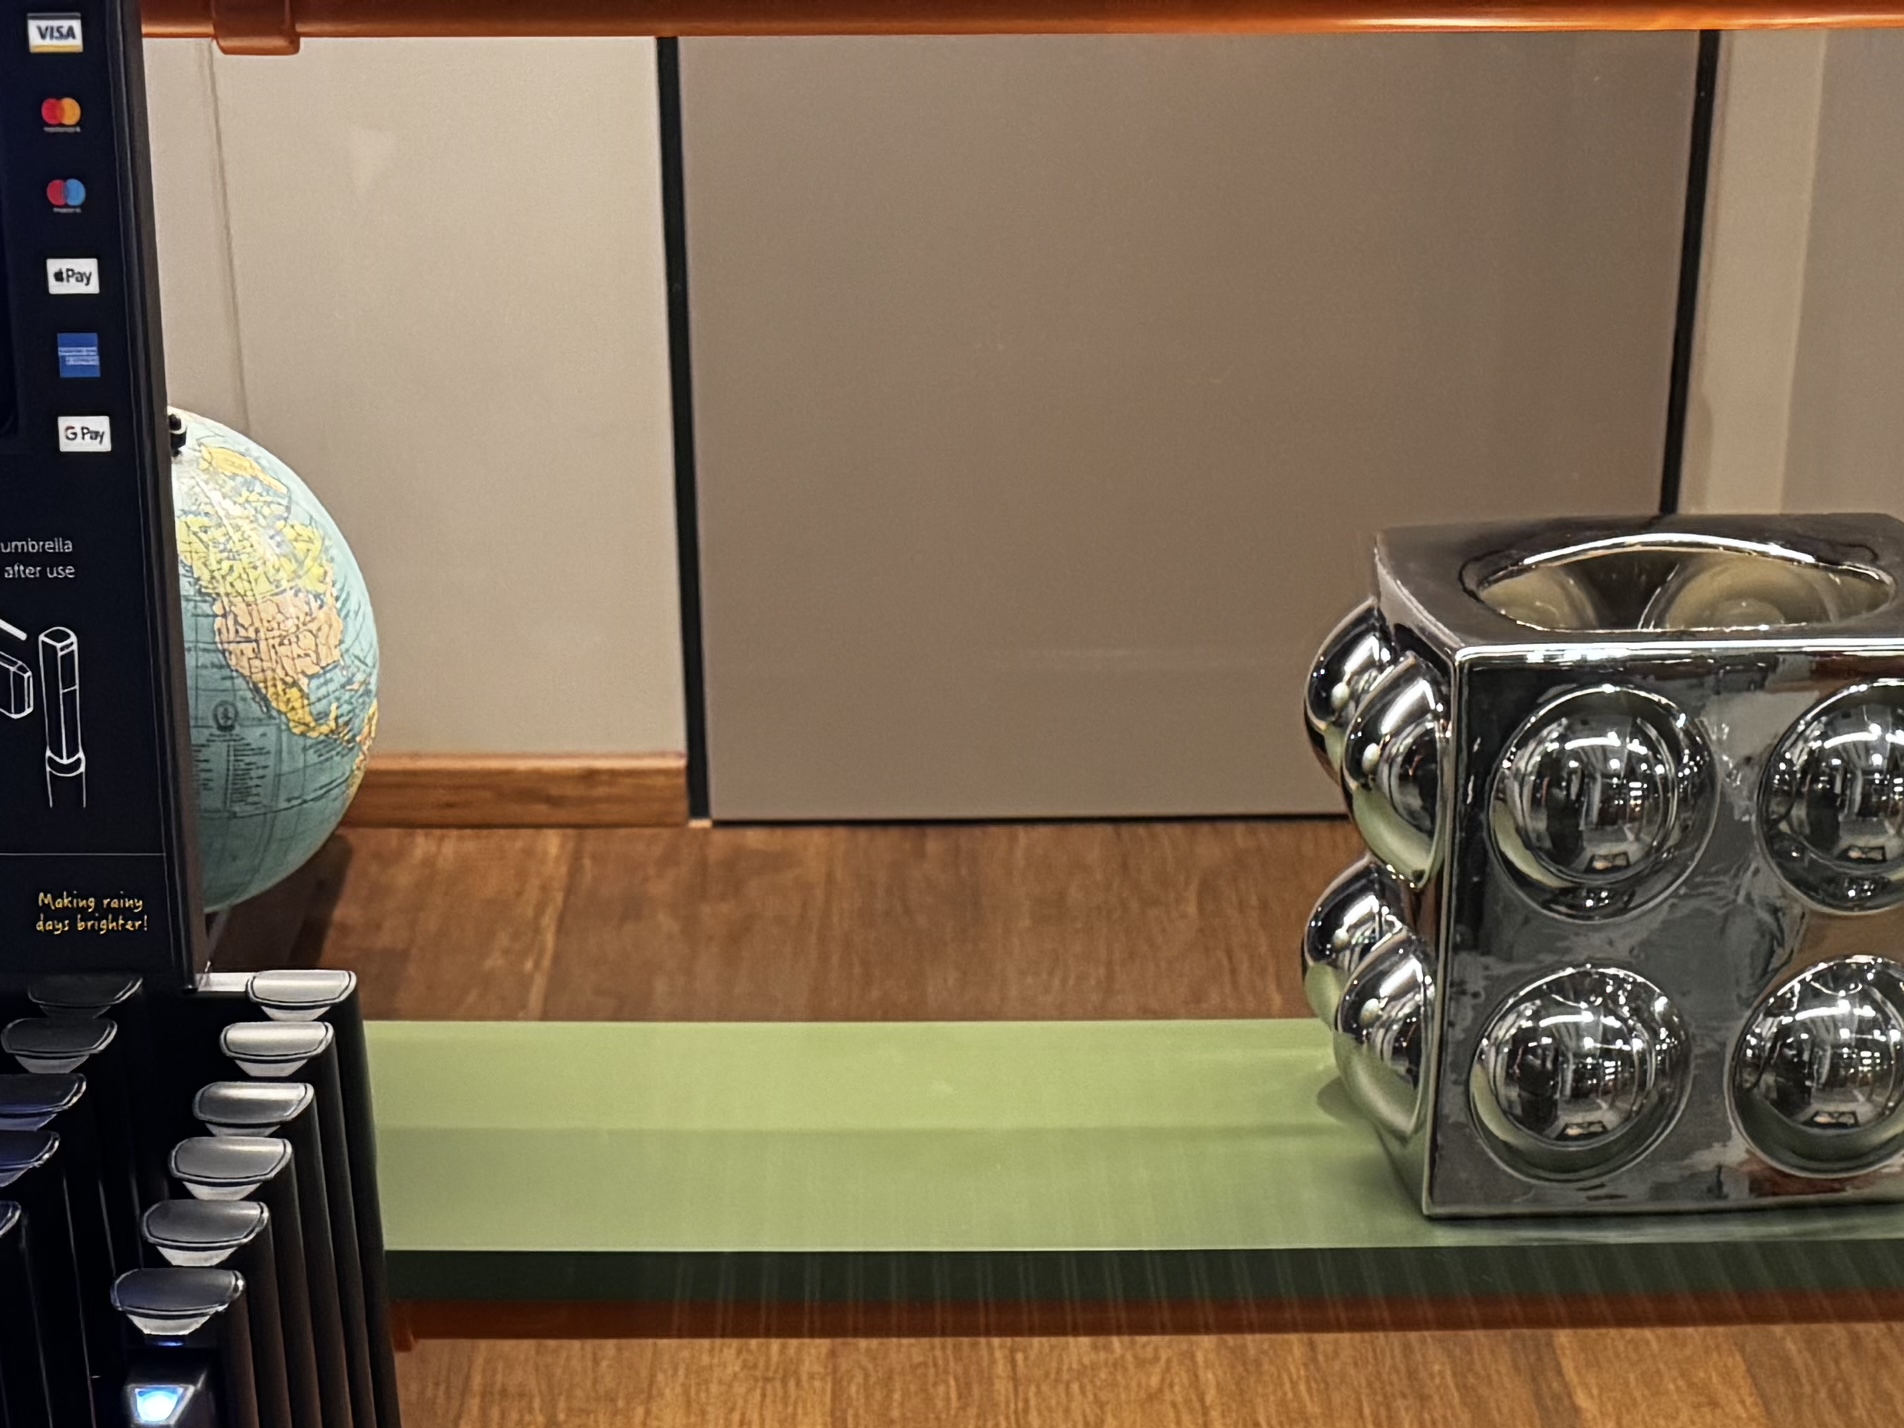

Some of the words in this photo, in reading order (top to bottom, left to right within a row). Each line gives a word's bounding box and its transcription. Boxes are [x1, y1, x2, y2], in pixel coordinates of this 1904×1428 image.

[36, 25, 77, 41] VISA
[65, 425, 77, 441] G
[81, 426, 105, 445] Pay
[0, 537, 73, 553] umbrella
[4, 563, 41, 578] after
[47, 565, 75, 578] use
[38, 891, 97, 914] Making
[102, 893, 145, 915] rainy
[35, 915, 71, 935] days
[76, 914, 149, 934] brighter!
